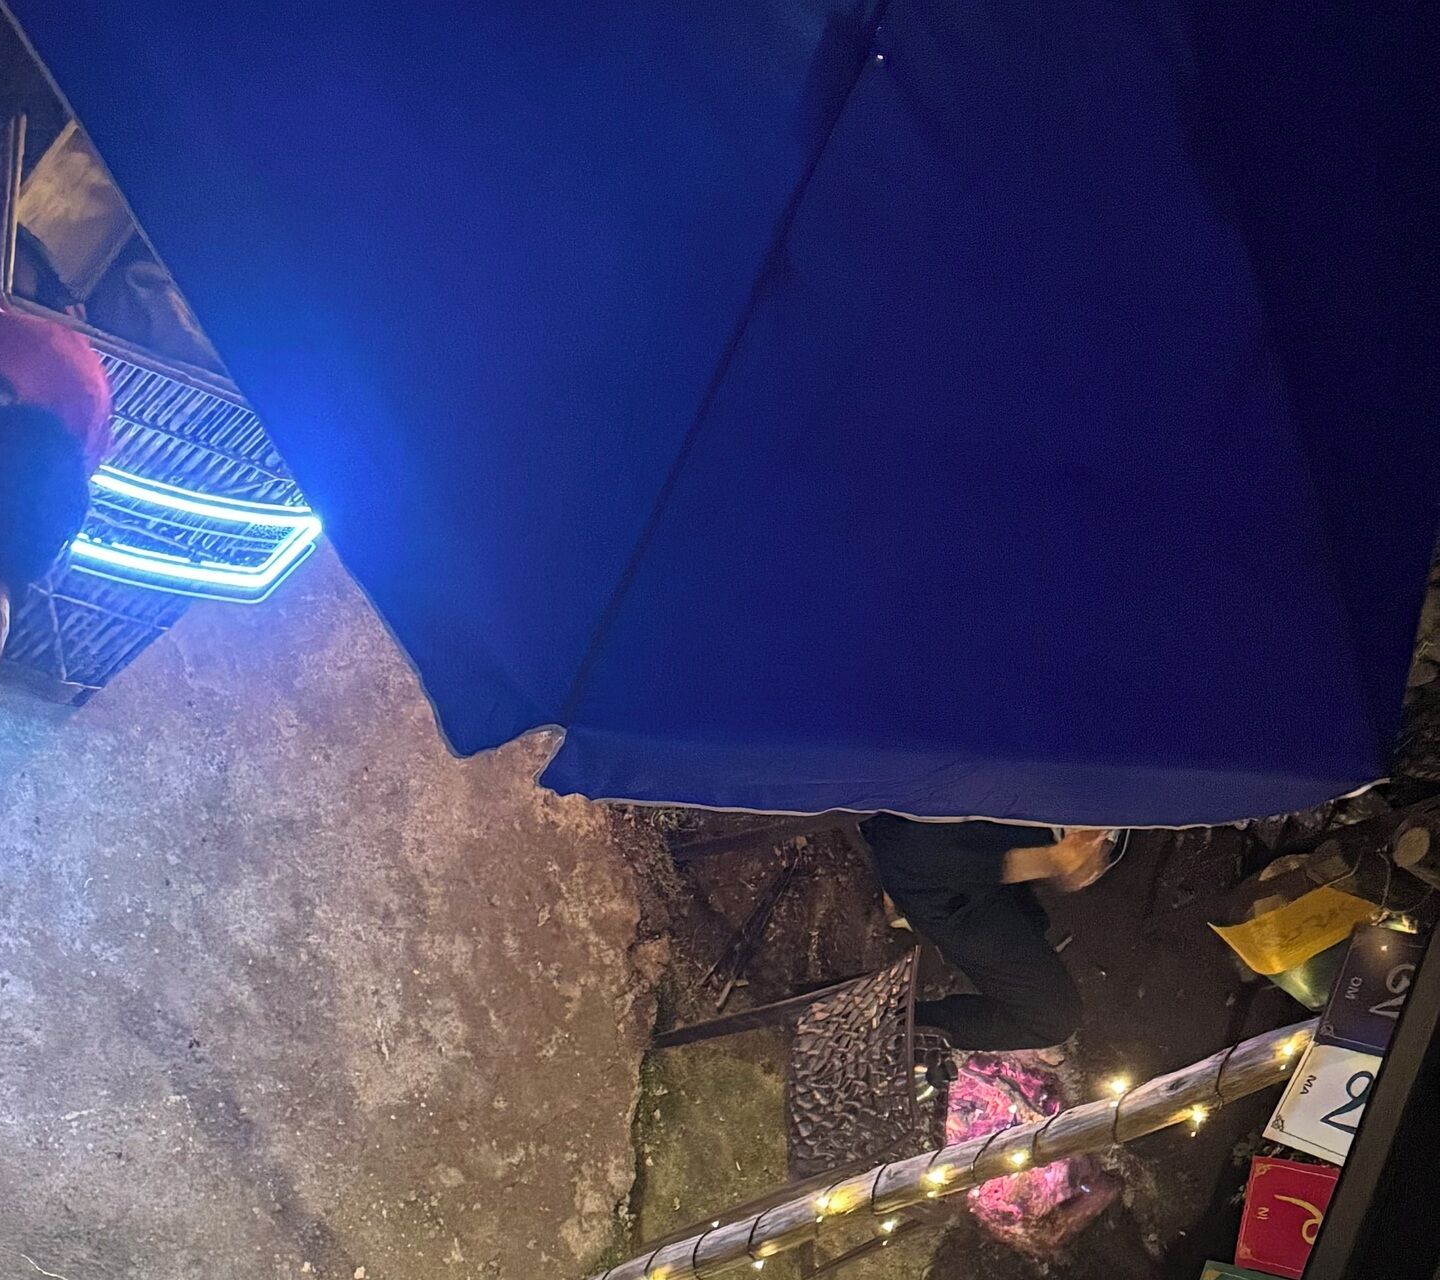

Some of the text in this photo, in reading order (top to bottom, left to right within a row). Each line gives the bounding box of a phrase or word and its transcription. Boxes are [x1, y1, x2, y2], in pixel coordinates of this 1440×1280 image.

[1345, 975, 1363, 1001] OM
[1300, 1074, 1317, 1095] MA
[1257, 1206, 1271, 1220] NI
